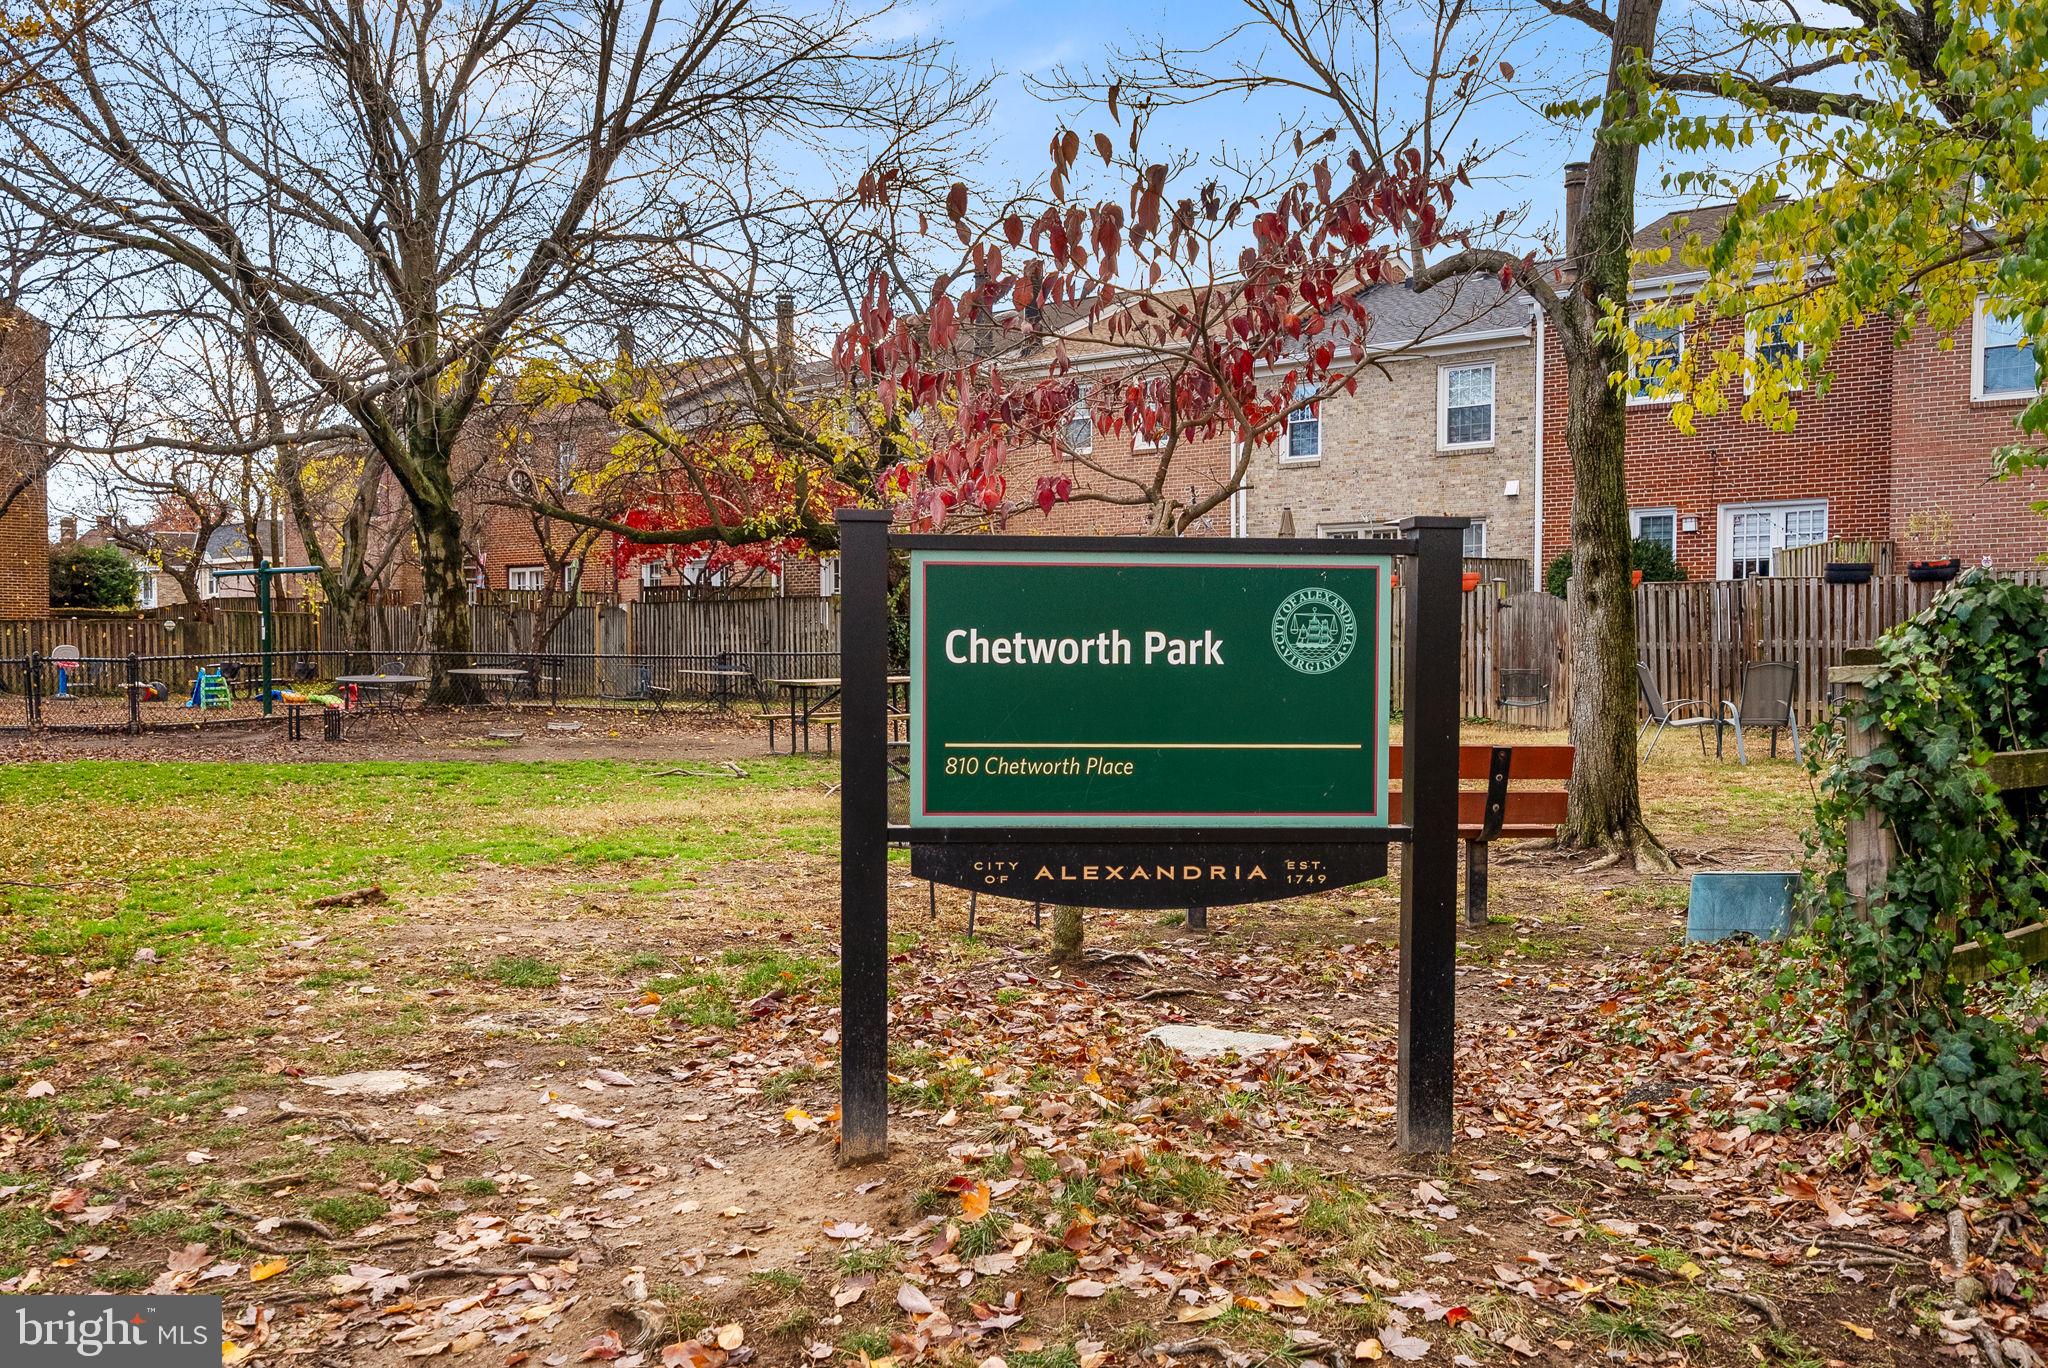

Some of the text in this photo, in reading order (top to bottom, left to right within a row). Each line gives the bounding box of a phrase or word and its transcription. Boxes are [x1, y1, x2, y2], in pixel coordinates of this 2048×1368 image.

[1275, 590, 1354, 646] CITY OF ALEXANDRIA
[945, 628, 1225, 665] Chetworth Park
[1282, 648, 1347, 672] VIRGINIA
[945, 756, 1134, 776] 810 Chetworth Place
[973, 861, 1019, 872] CITY
[1034, 865, 1268, 881] ALEXANDRIA
[1286, 860, 1327, 871] EST.
[984, 874, 1010, 884] OF
[1286, 874, 1327, 885] 1749
